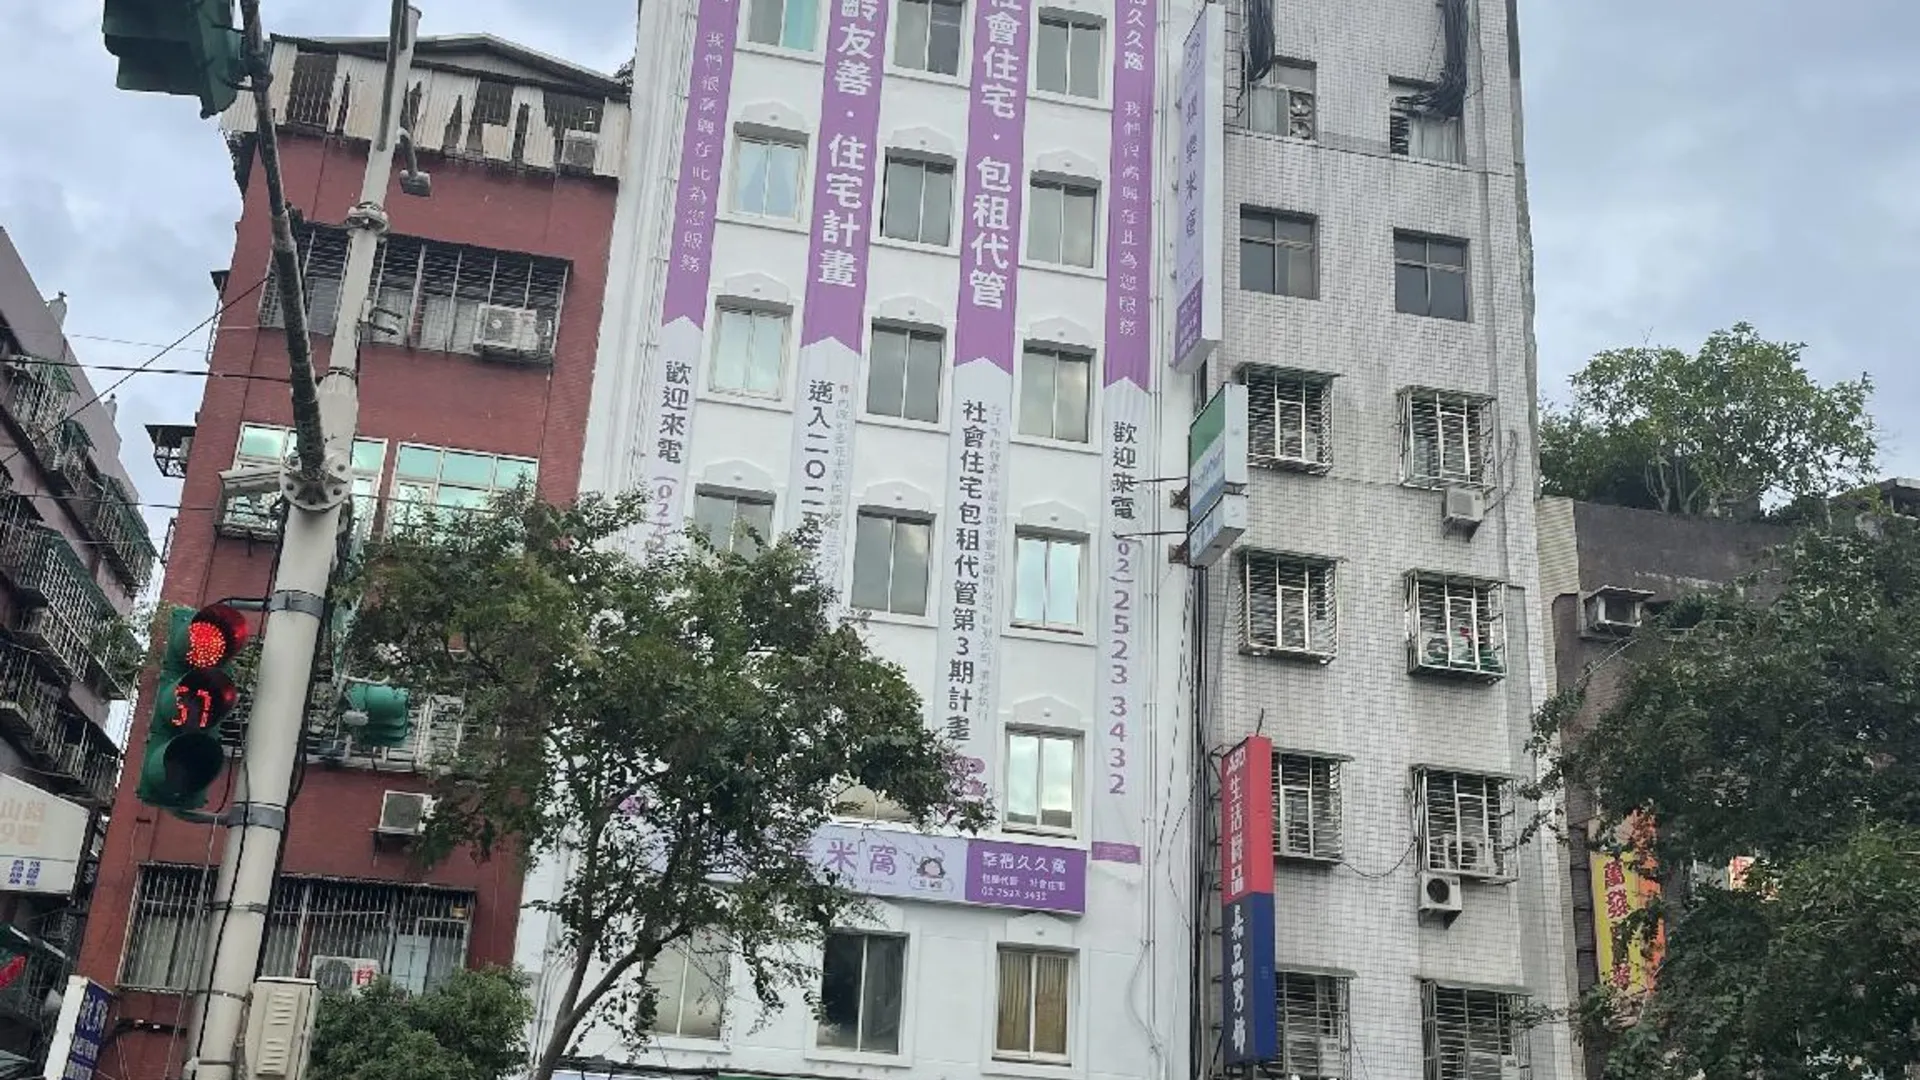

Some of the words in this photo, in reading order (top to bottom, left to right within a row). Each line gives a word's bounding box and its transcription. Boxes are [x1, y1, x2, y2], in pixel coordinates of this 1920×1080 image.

[1124, 0, 1146, 72] 久久窩
[656, 360, 692, 464] 歡迎來電
[1111, 421, 1138, 520] 歡迎來電
[946, 399, 988, 741] 社會住宅包租代管第3期計畫
